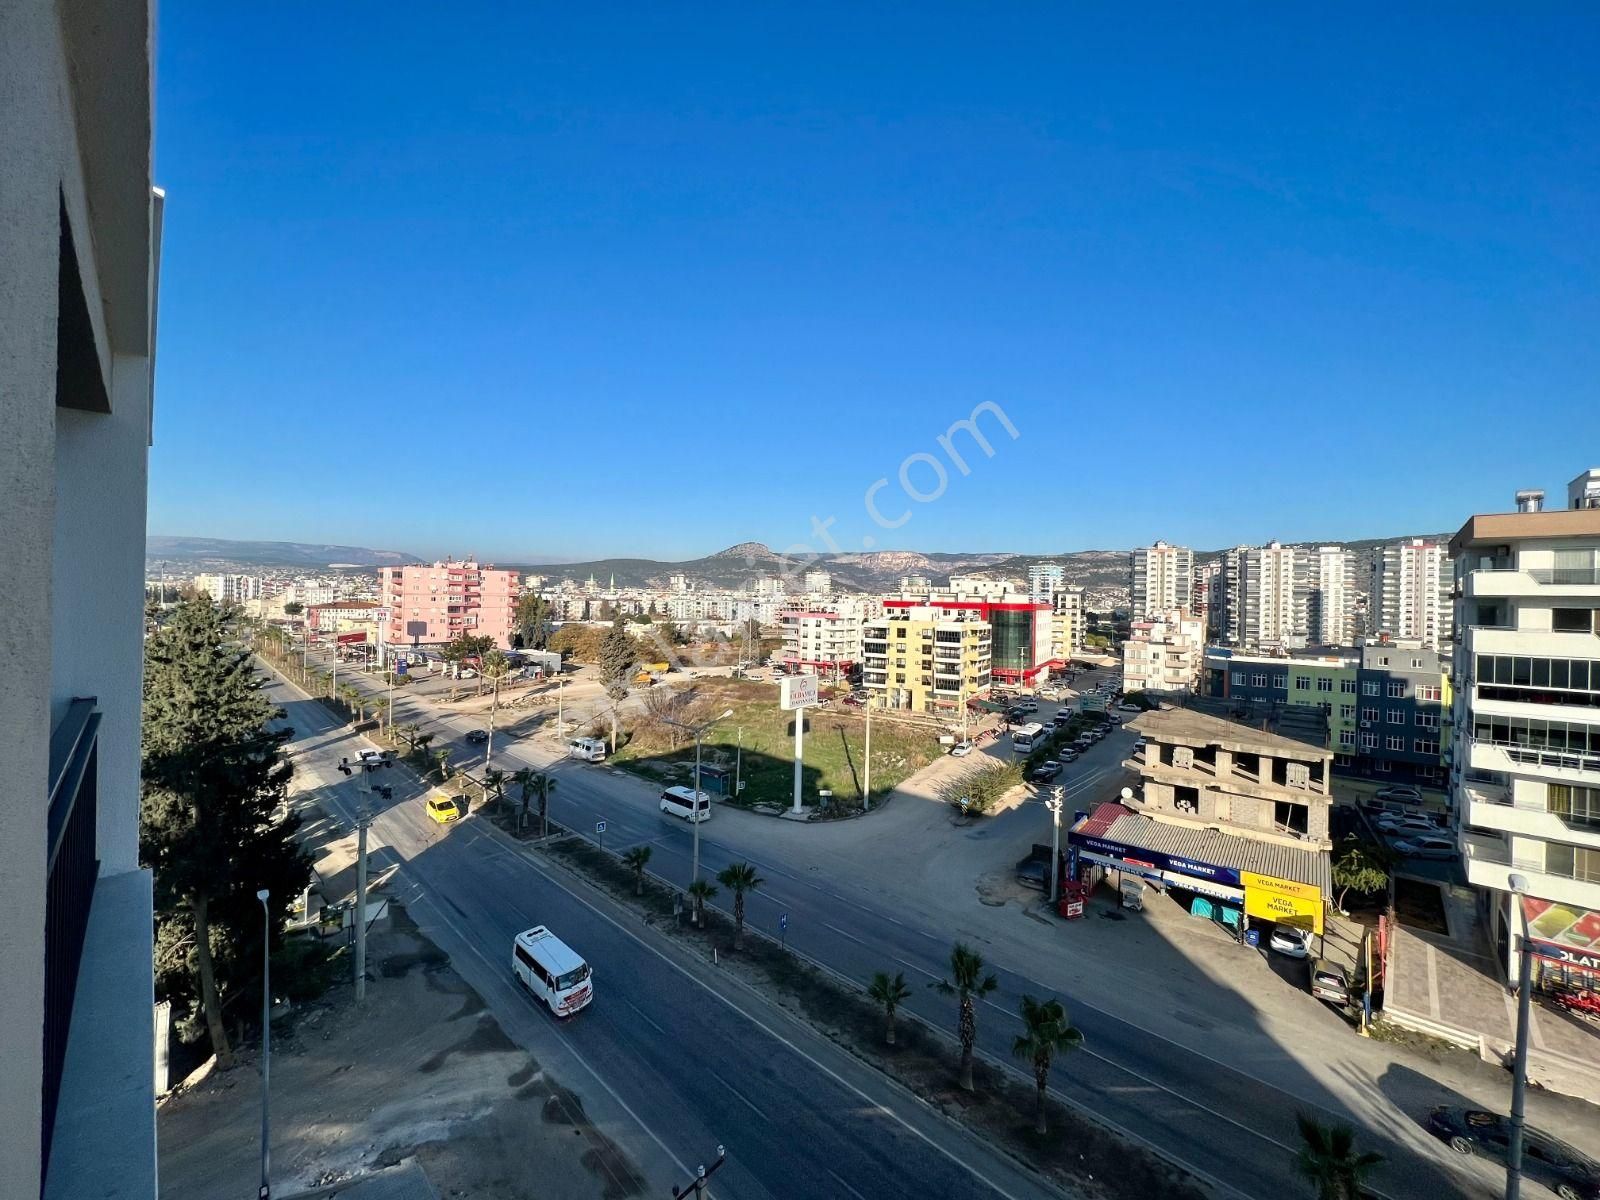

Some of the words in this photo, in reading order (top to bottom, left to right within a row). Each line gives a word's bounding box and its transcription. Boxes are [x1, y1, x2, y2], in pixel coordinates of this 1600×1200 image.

[1169, 859, 1187, 869] VEGA
[1188, 863, 1216, 875] MARKET
[1257, 879, 1274, 887] VEGA
[1275, 883, 1301, 893] MARKET
[1273, 897, 1293, 907] VEGA
[1267, 903, 1298, 916] MARKET
